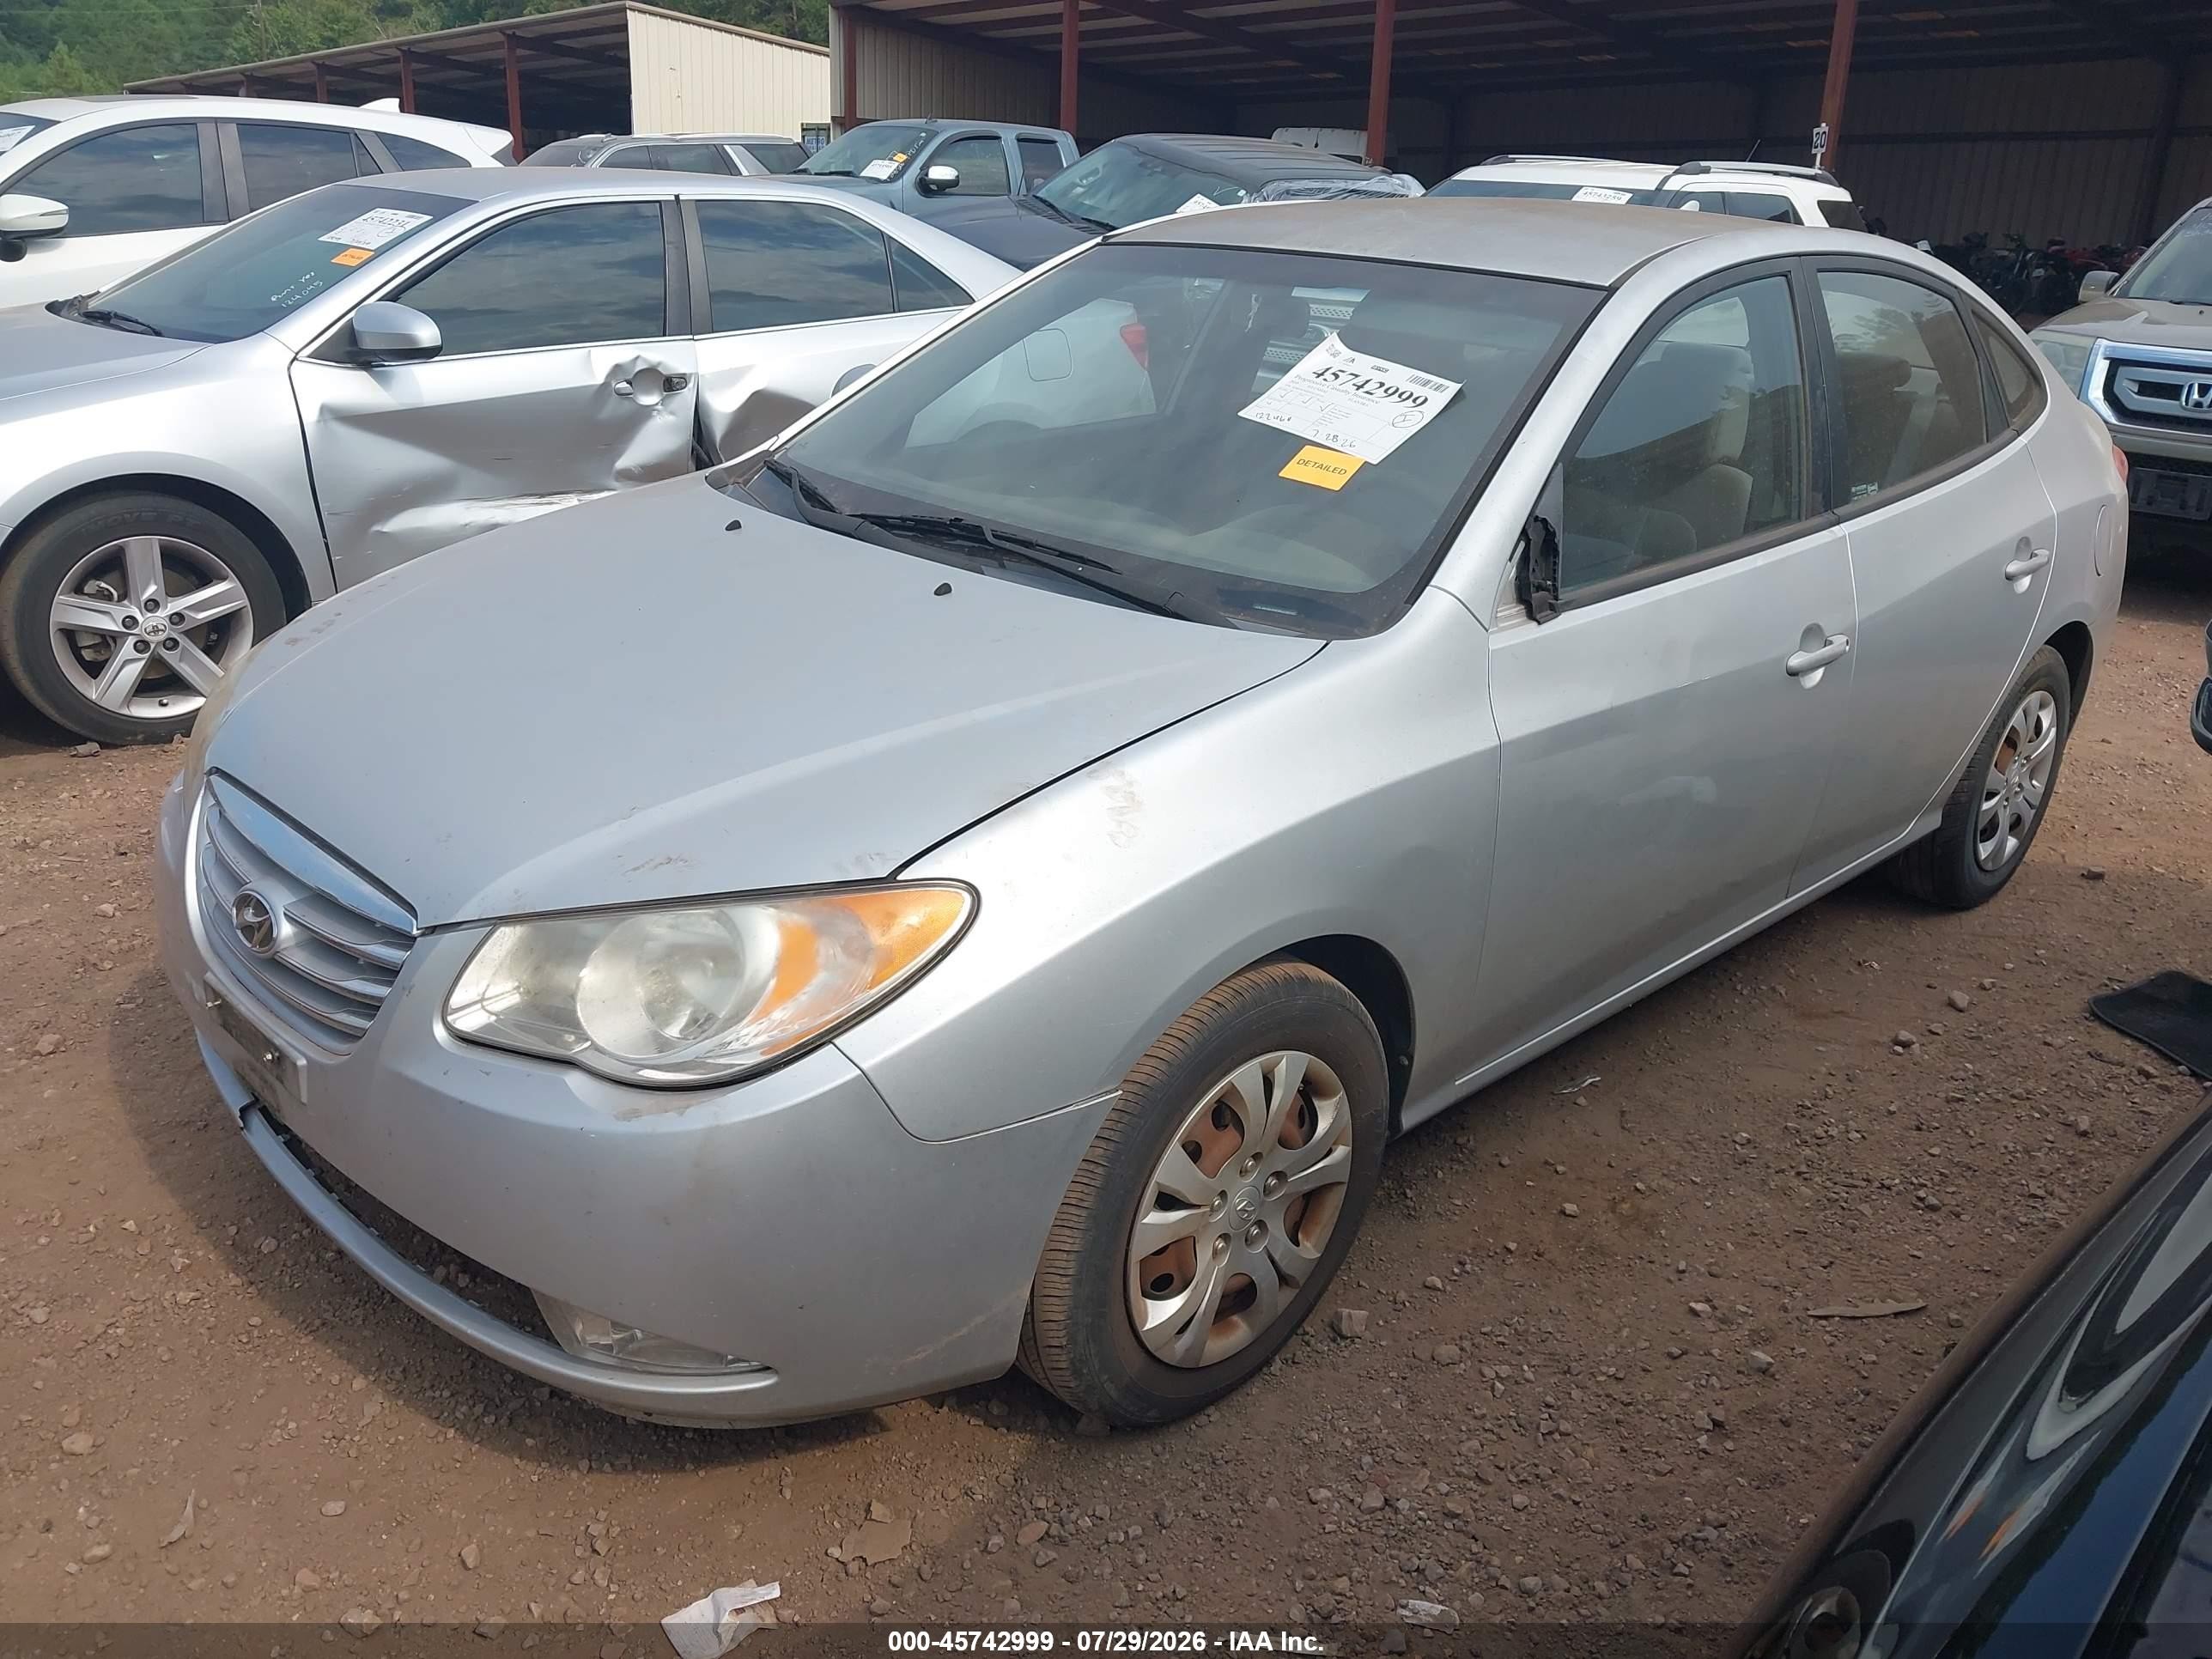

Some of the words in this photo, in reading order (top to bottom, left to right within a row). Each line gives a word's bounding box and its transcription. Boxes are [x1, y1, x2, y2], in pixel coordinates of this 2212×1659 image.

[1814, 131, 1826, 149] 20
[1312, 366, 1429, 409] 45742999
[1297, 459, 1347, 476] DETAILED
